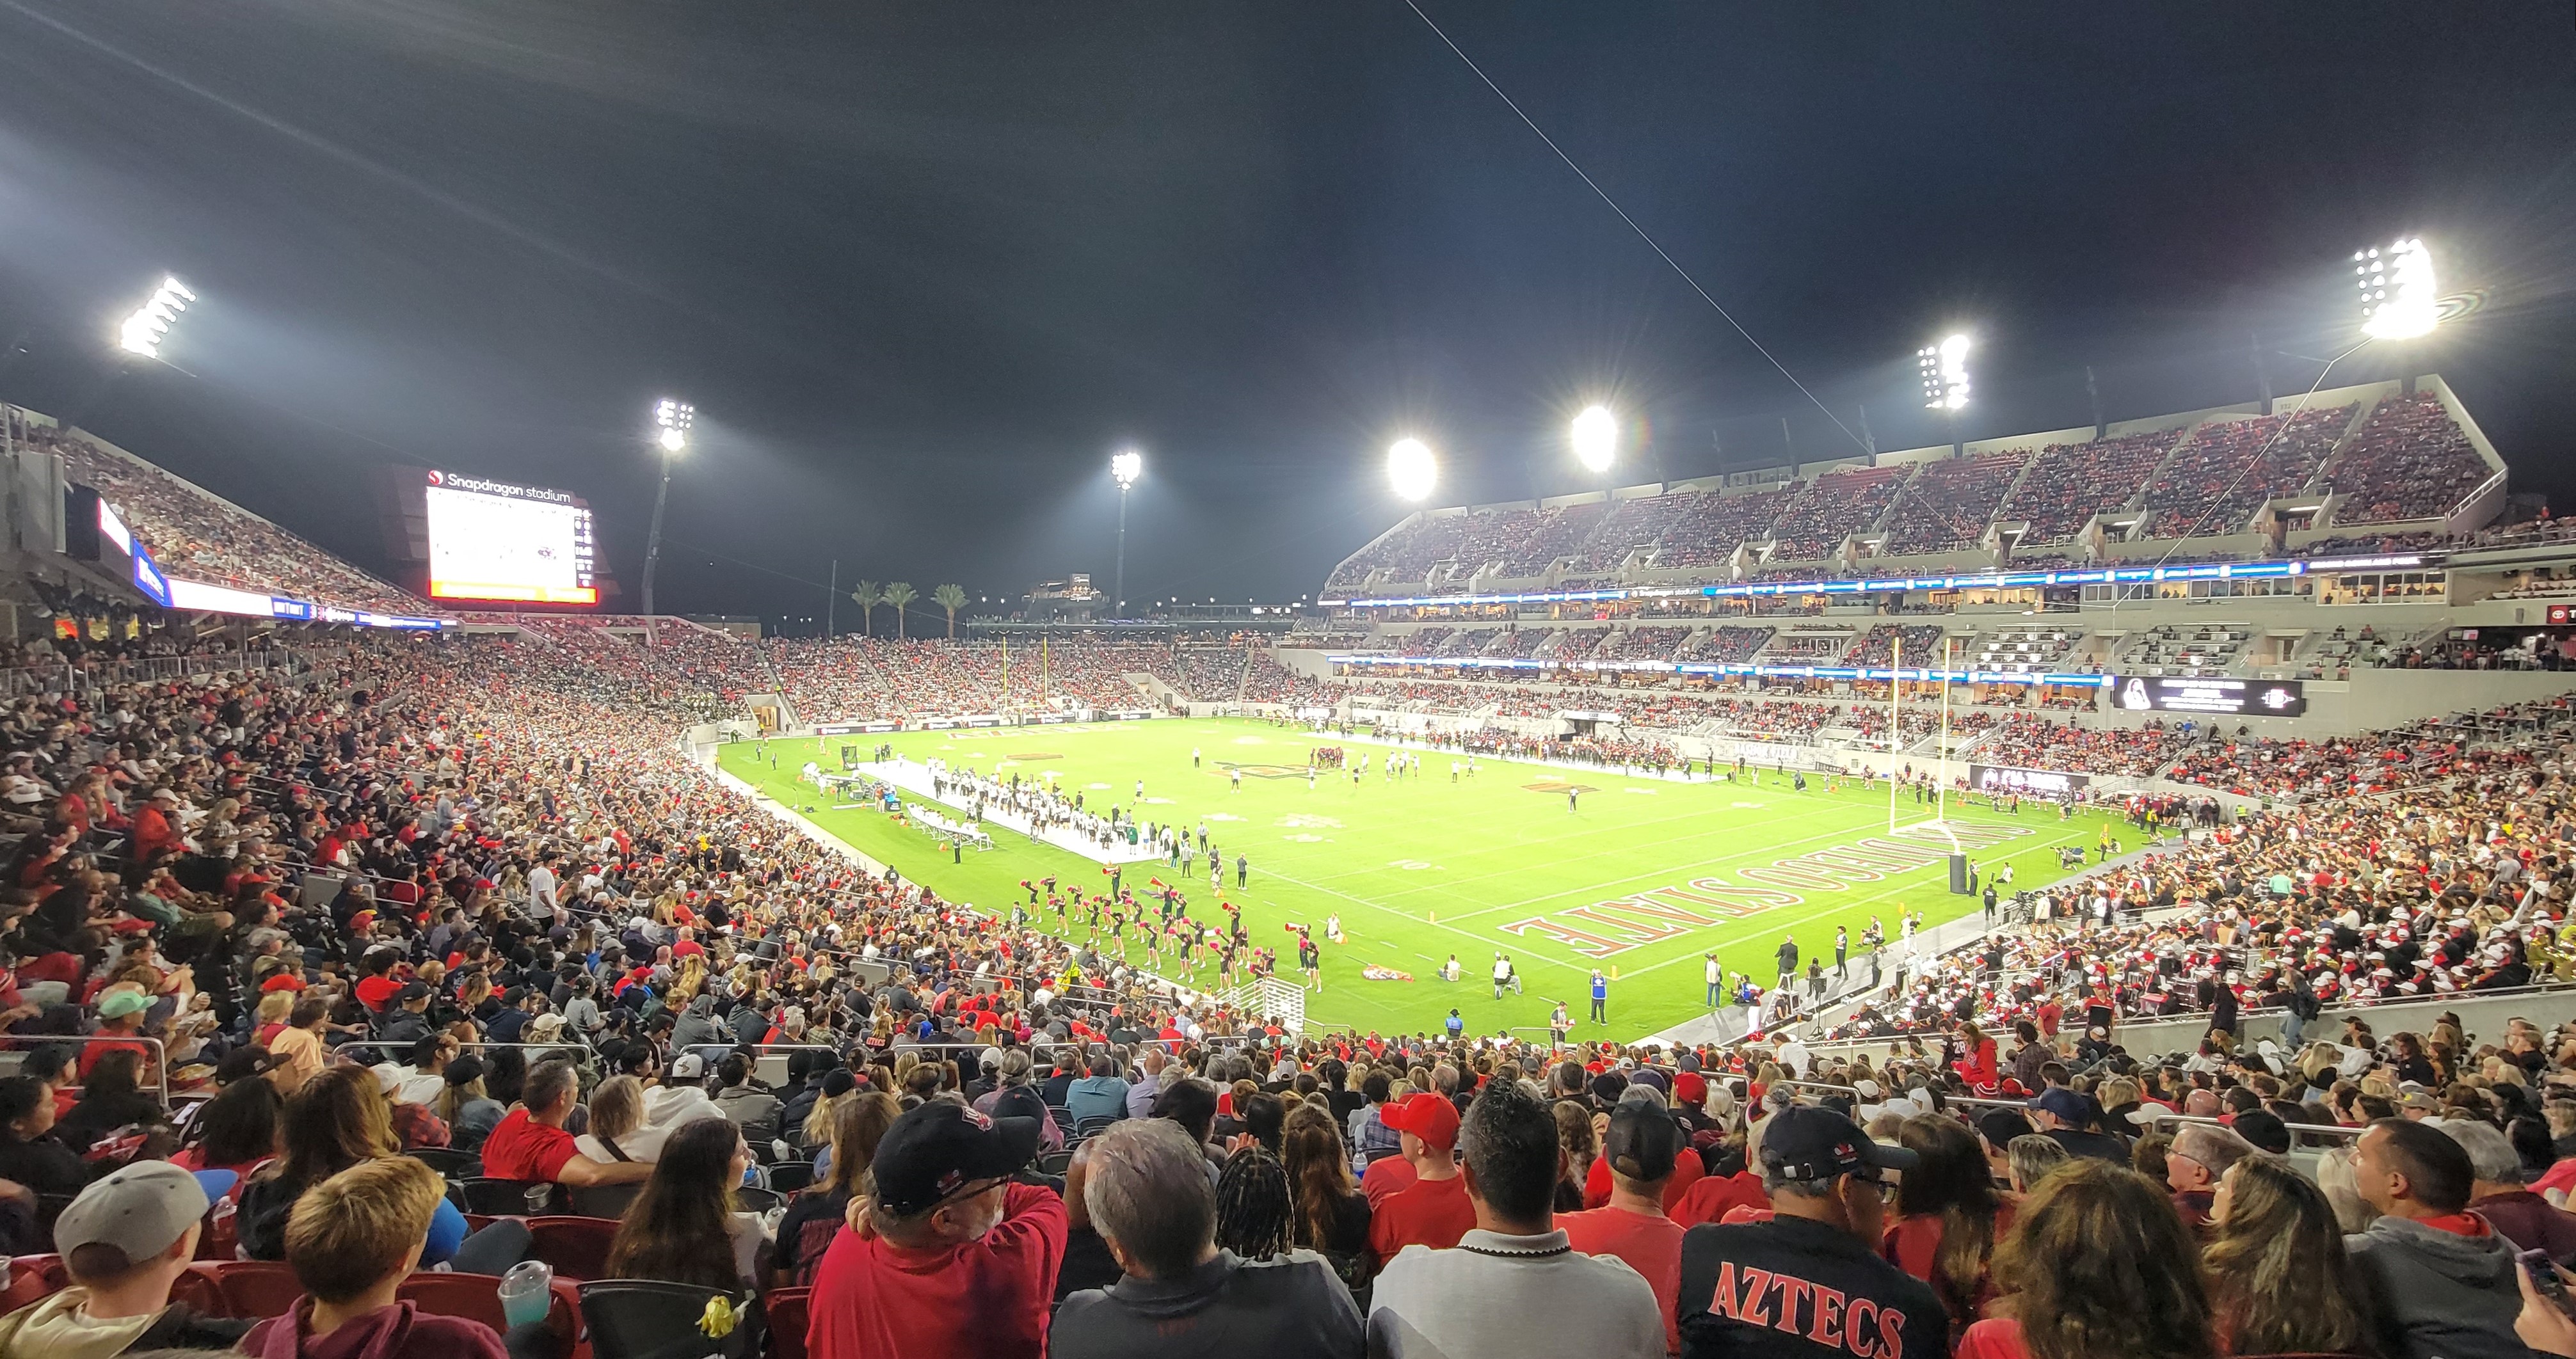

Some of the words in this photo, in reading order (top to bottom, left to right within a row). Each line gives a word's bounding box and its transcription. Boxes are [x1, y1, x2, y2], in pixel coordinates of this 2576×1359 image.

[447, 473, 524, 496] Snapdragon
[525, 487, 571, 503] stadium
[1496, 877, 1804, 959] STATE
[1953, 1041, 1966, 1054] 28
[1708, 1261, 1906, 1359] AZTECS
